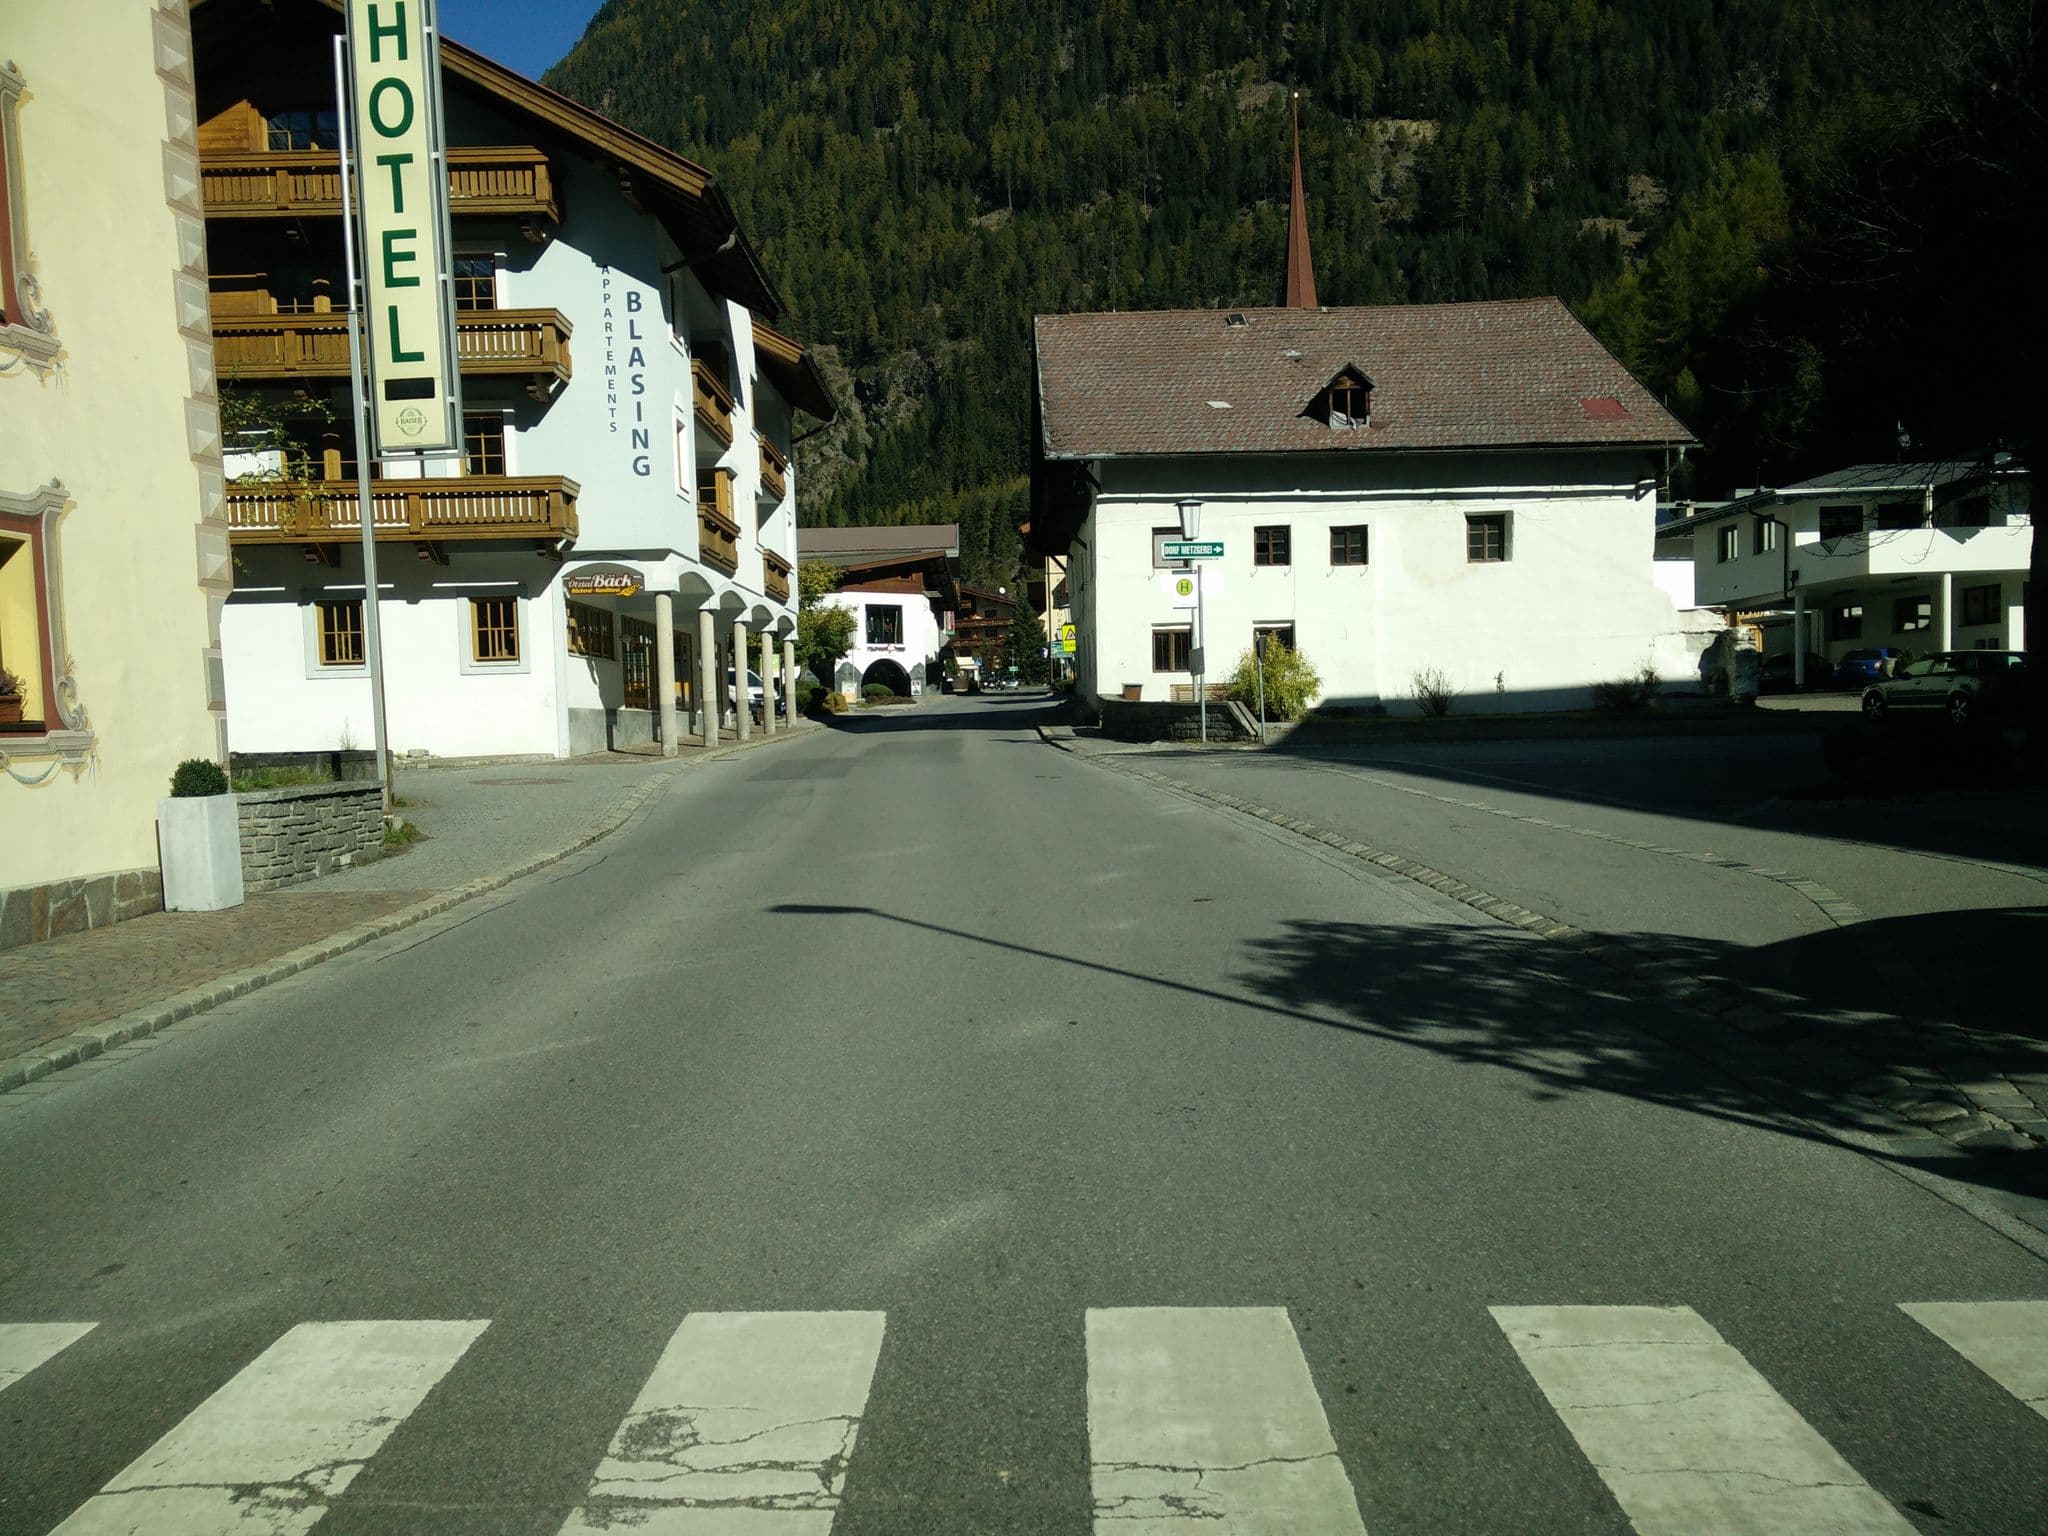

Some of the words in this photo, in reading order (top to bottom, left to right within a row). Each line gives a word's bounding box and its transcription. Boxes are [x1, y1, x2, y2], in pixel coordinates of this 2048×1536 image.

[367, 1, 425, 363] HOTEL
[601, 266, 617, 432] APPARTEMENTS
[626, 291, 650, 477] BLASING
[400, 416, 423, 425] KAISER
[1164, 545, 1179, 555] DORF
[1181, 545, 1212, 555] METZGEREI
[593, 574, 631, 587] Bäck
[1180, 582, 1189, 592] H
